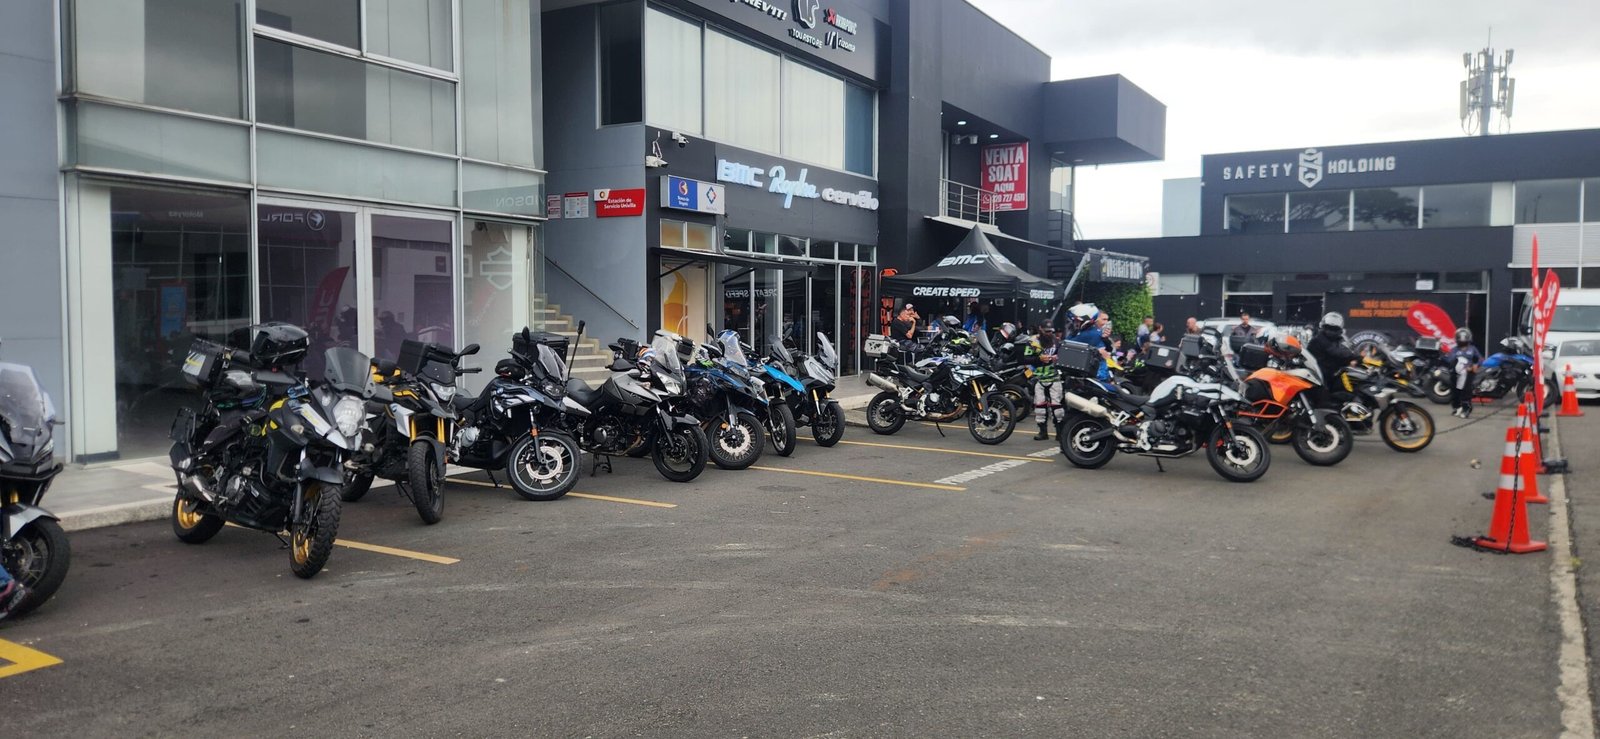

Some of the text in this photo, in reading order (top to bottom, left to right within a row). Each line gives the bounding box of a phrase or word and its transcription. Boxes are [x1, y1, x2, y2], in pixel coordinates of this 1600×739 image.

[838, 37, 856, 52] rizoma
[985, 147, 1025, 165] VENTA
[717, 159, 764, 188] BMC
[989, 164, 1020, 182] SOAT
[1223, 156, 1396, 180] SAFETY HOLDING
[1003, 193, 1013, 202] 727
[937, 254, 988, 267] BMC
[913, 287, 981, 297] CREATE SPEED
